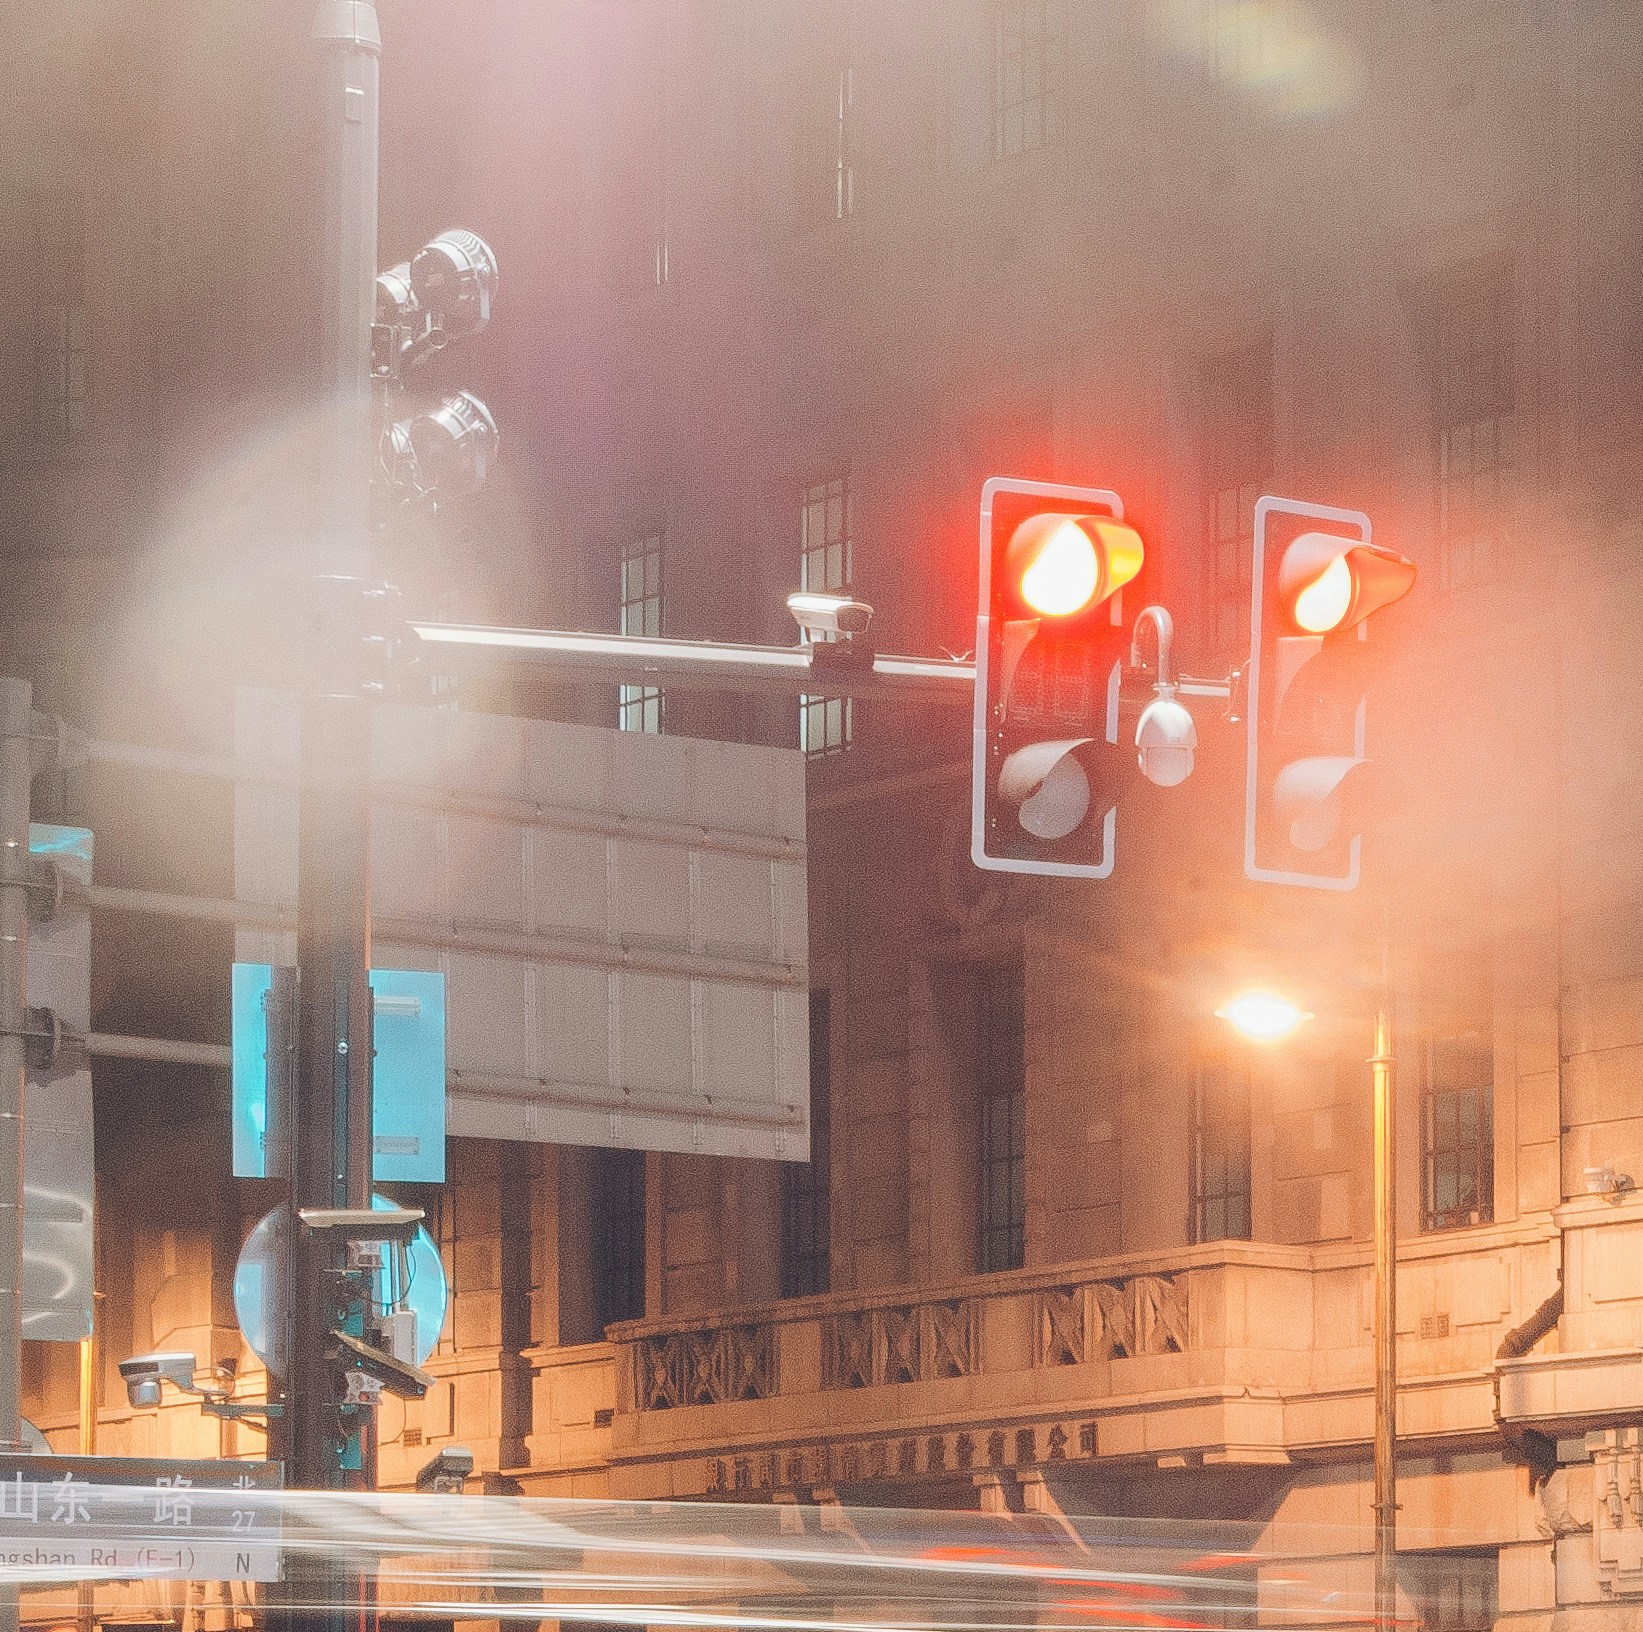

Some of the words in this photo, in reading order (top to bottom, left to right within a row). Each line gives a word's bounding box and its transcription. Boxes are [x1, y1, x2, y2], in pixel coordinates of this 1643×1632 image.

[232, 1510, 256, 1532] 27
[91, 1548, 118, 1567] Rd
[236, 1553, 250, 1573] N
